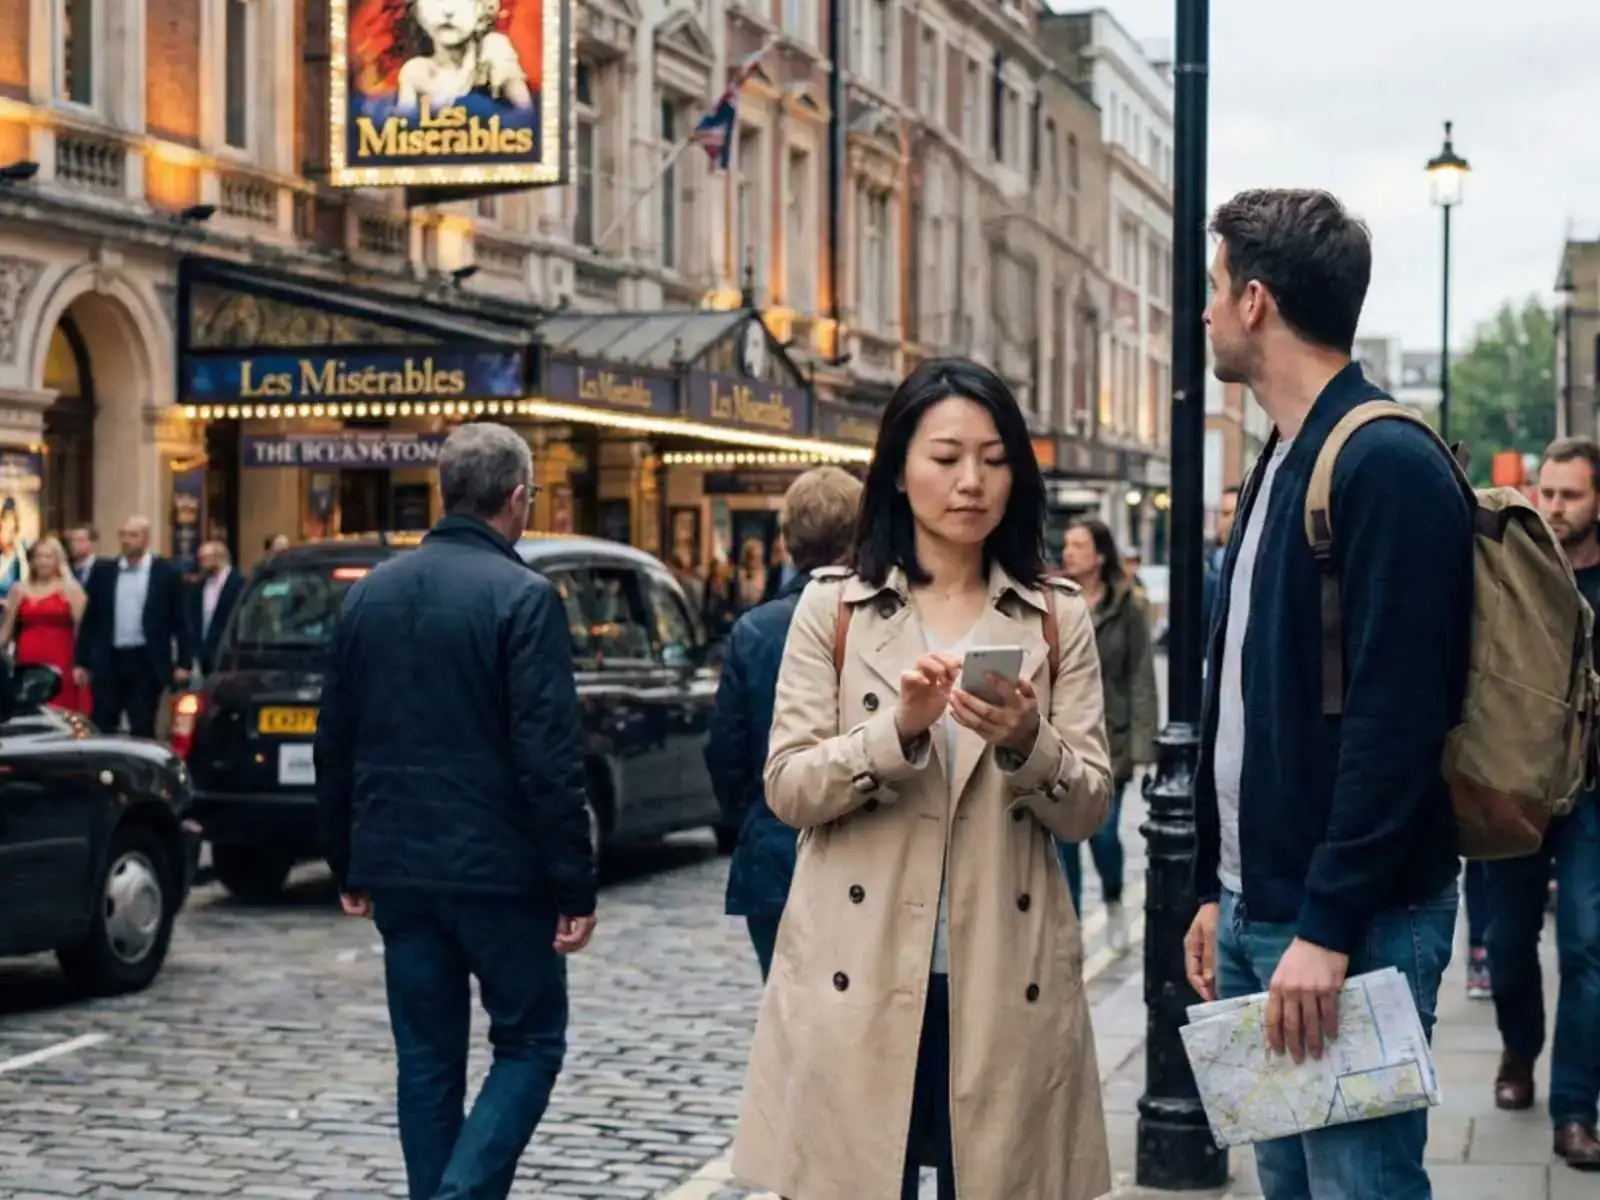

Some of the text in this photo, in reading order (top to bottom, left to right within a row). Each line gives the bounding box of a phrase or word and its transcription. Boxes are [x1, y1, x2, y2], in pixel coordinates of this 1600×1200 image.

[420, 94, 467, 127] Les
[240, 356, 466, 397] Les Misérables
